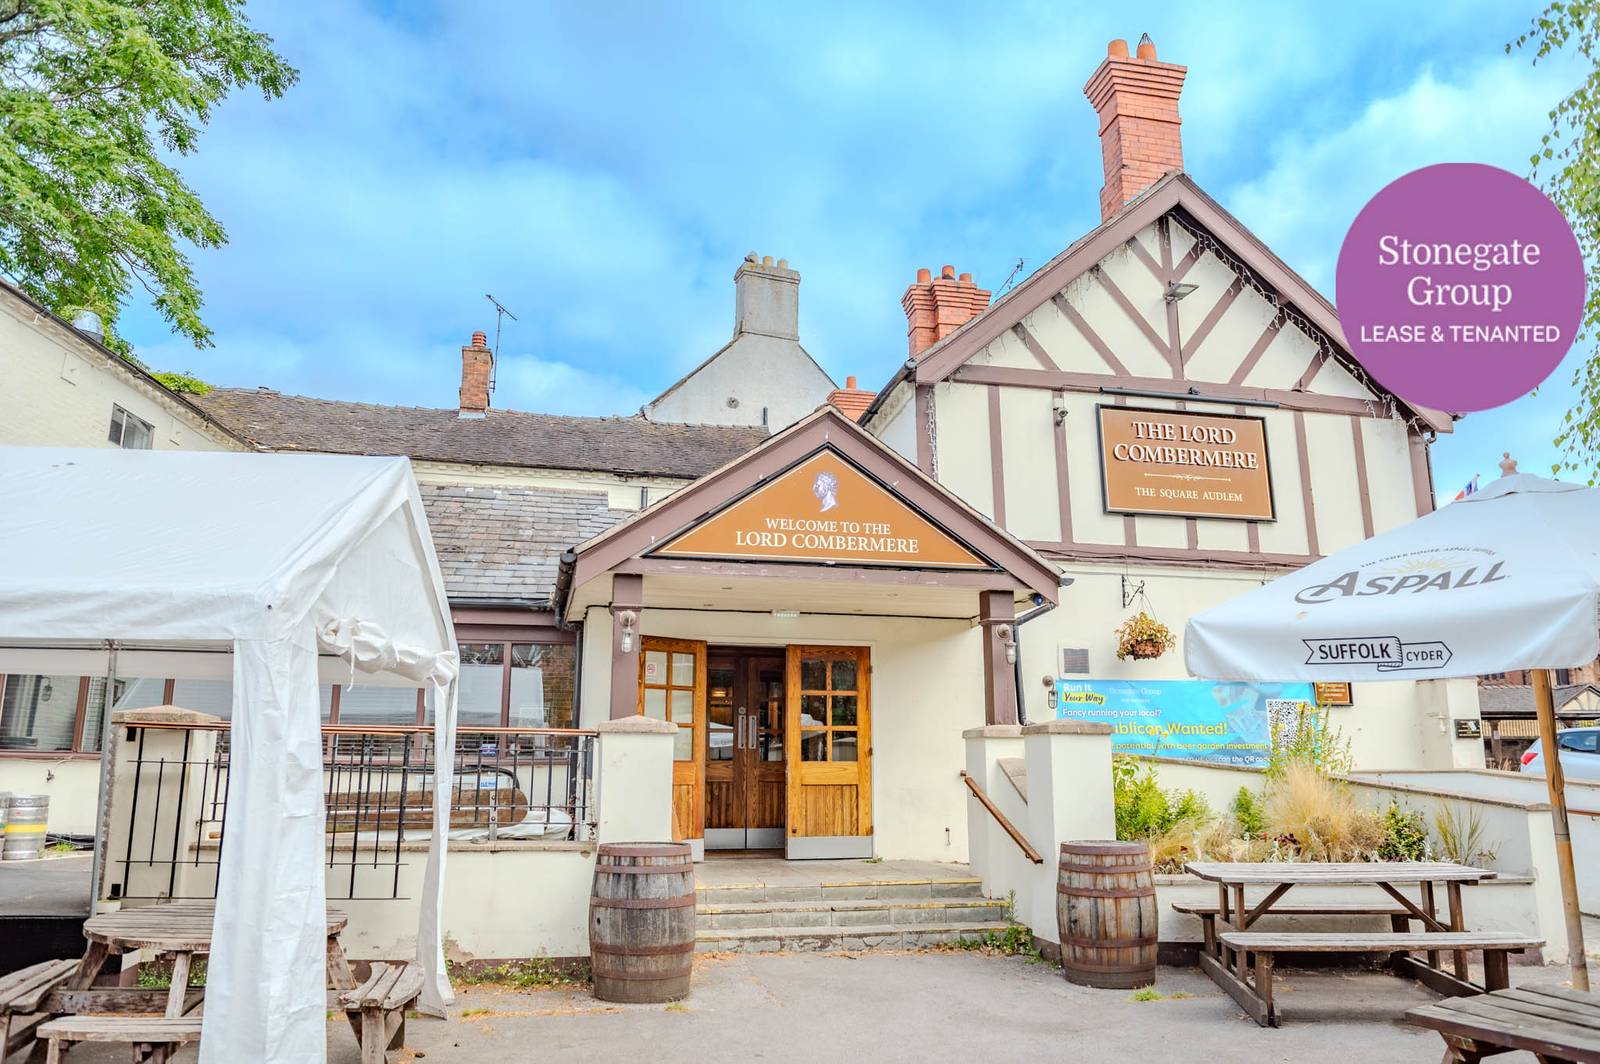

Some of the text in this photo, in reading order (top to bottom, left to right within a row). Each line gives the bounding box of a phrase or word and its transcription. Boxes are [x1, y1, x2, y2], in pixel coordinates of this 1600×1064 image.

[1131, 421, 1237, 444] THE LORD
[1113, 443, 1259, 469] COMBERMERE
[1134, 487, 1243, 502] THE SQUARE AUDLEM
[765, 518, 891, 535] WELCOME TO THE
[735, 530, 919, 553] LORD COMBERMERE
[1294, 560, 1506, 604] ASPALL
[1318, 642, 1444, 662] SUFFOLK CYDER
[1063, 683, 1082, 692] Run
[1064, 692, 1104, 705] Your Way
[1063, 708, 1162, 718] Fancy running your local?
[1167, 721, 1228, 735] Wanted!
[1197, 743, 1225, 752] garden
[1244, 755, 1255, 763] QR
